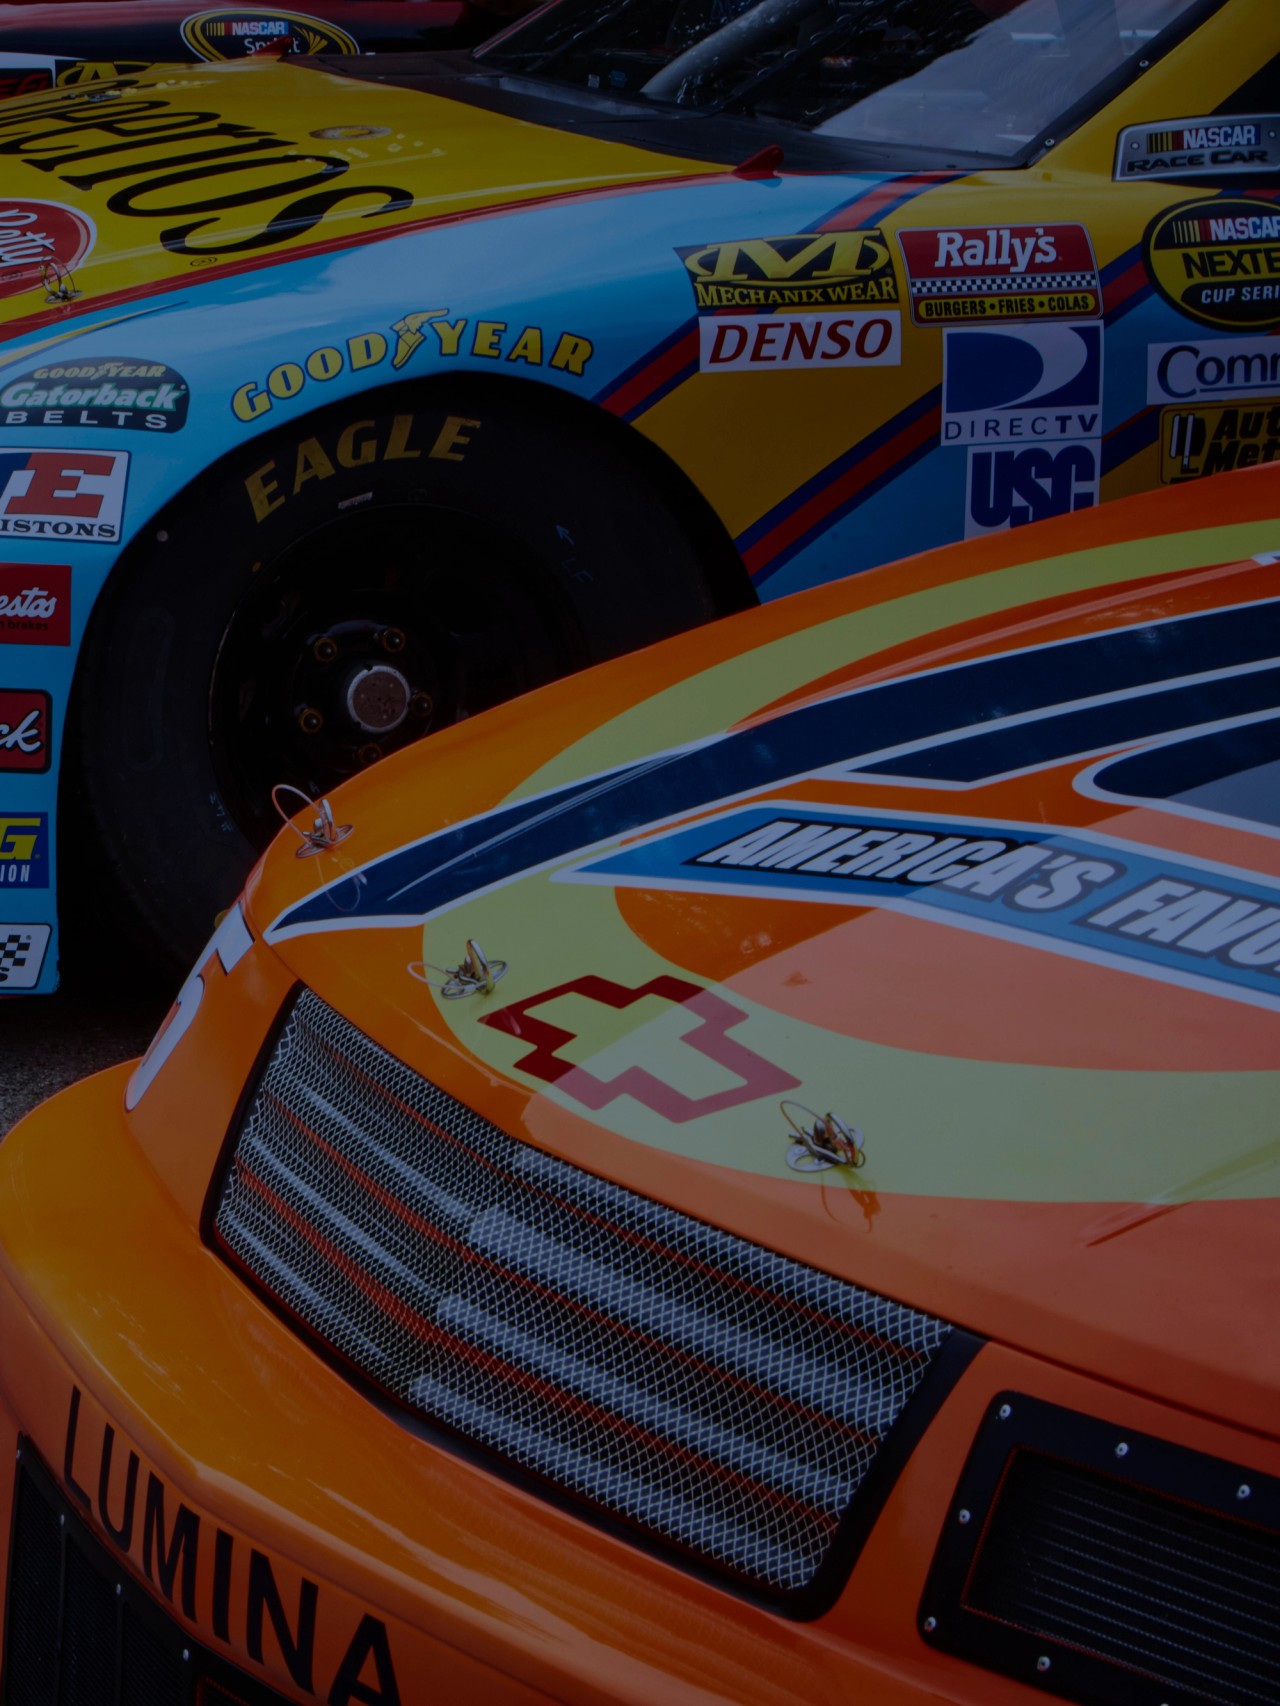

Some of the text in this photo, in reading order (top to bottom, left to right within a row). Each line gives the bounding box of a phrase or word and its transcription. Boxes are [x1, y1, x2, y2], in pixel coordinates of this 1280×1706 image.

[231, 22, 286, 36] NASCAR
[1183, 125, 1257, 150] NASCAR
[1127, 151, 1269, 173] RACE CAR
[934, 227, 1058, 274] Rally's
[694, 276, 898, 307] MECHANIX WEAR
[1200, 289, 1236, 305] CUP
[925, 295, 1090, 317] BURGERS FRIES COLAS
[708, 318, 893, 364] DENSO
[0, 381, 186, 411] Gatorback
[4, 410, 169, 430] BELTS
[944, 414, 1099, 440] DIRECTV
[244, 413, 483, 524] EAGLE
[697, 820, 1118, 912] AMERICA'S
[63, 1384, 402, 1706] LUMINA
